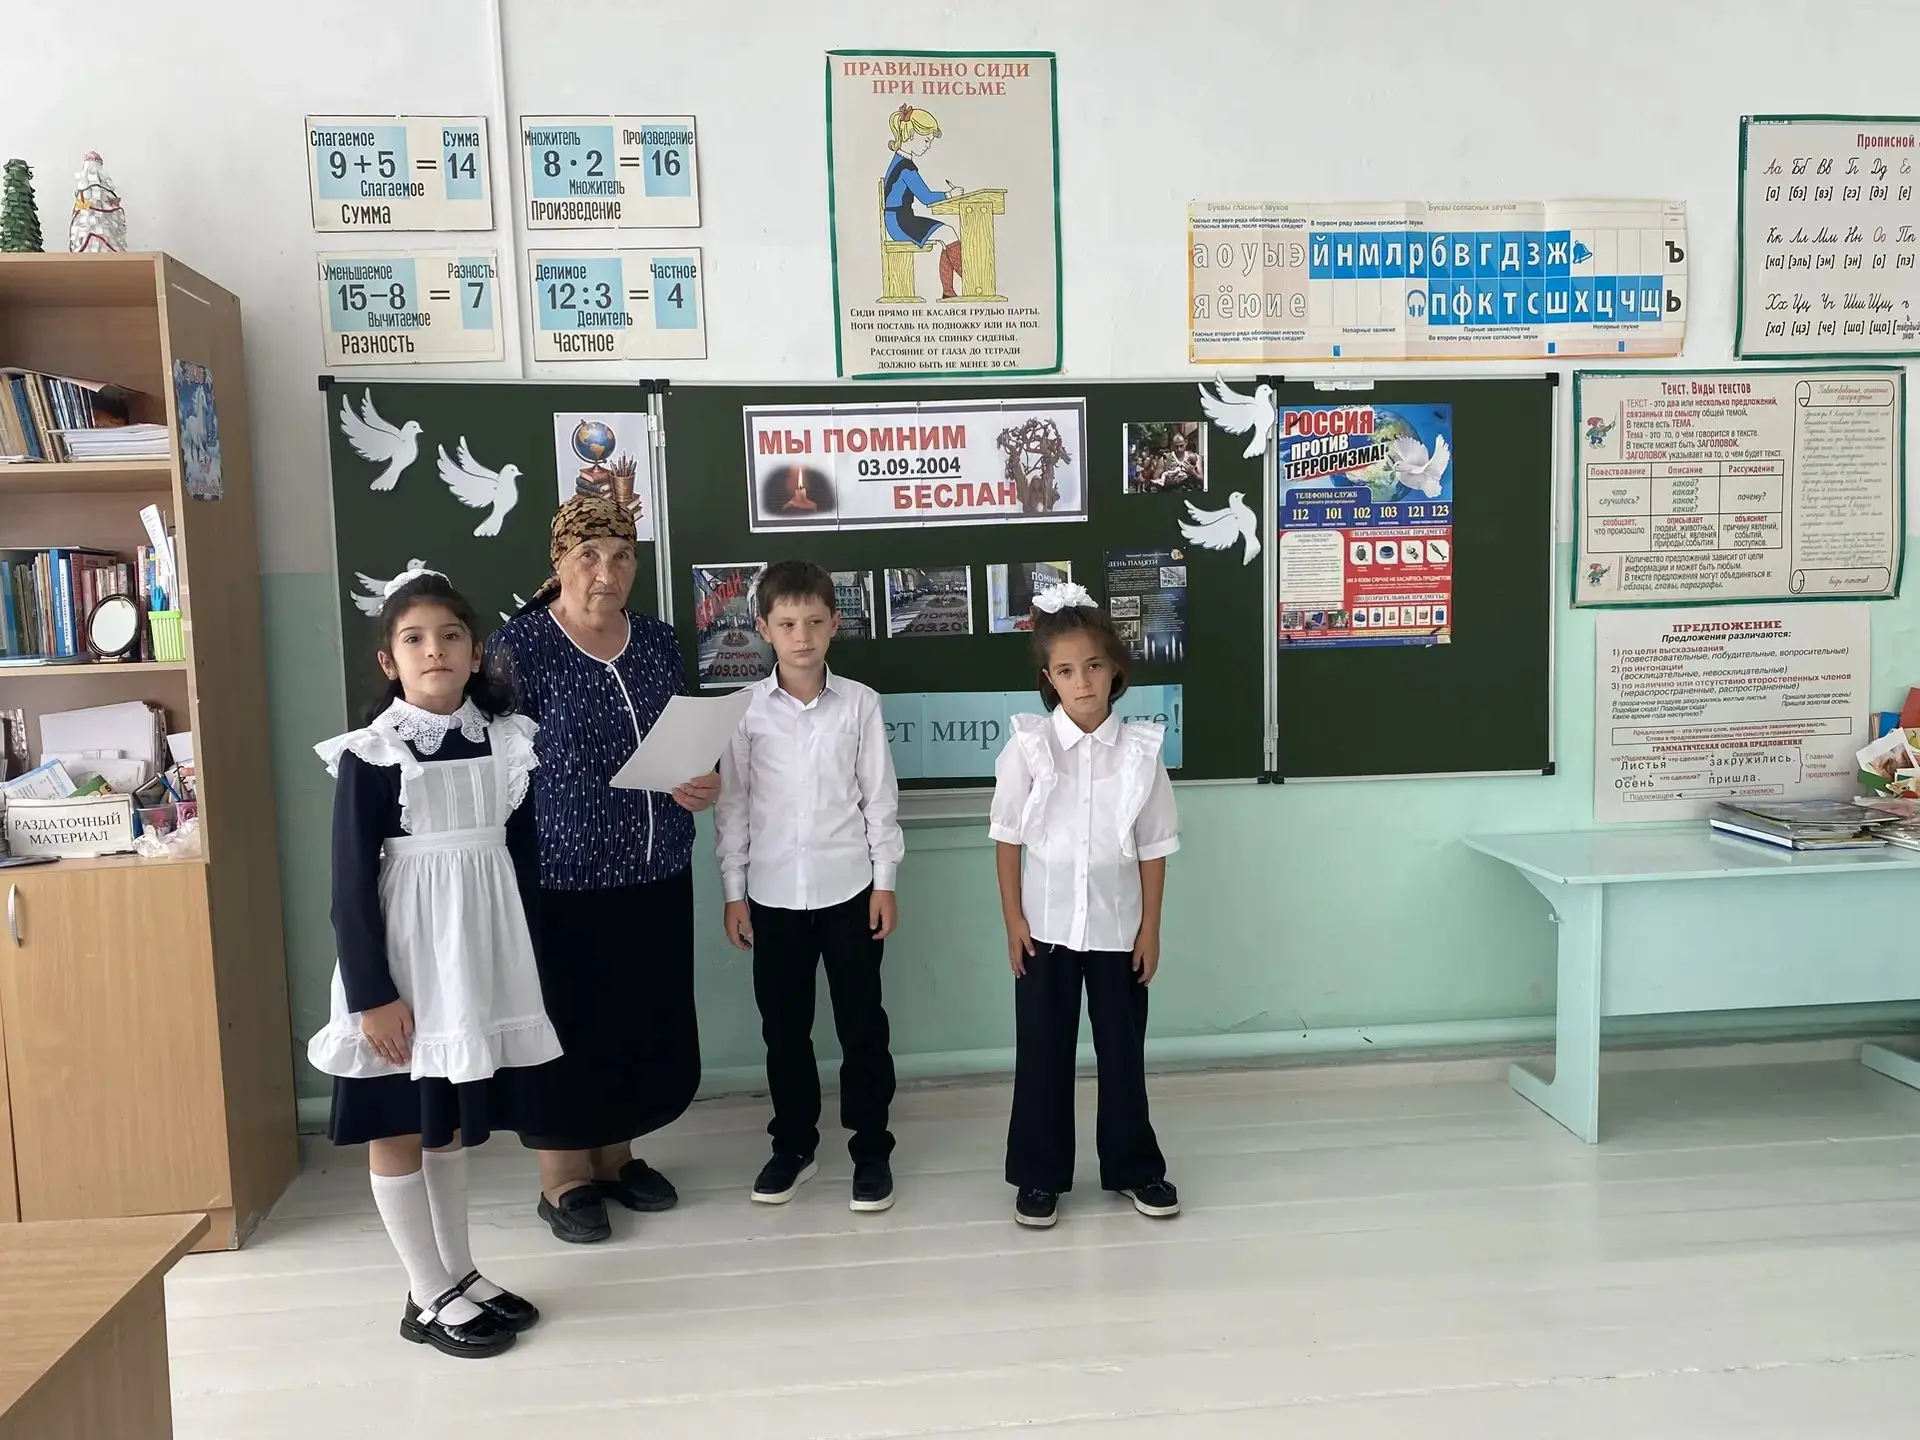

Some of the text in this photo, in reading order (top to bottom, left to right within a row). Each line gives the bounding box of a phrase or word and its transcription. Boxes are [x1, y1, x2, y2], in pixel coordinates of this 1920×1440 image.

[843, 62, 1030, 78] ПРАВИЛЬНО СИДИ
[872, 80, 1007, 96] ПРИ ПИСЬМЕ
[310, 130, 479, 148] Слагаемое Сумма
[524, 129, 693, 146] Множитель Произведение
[1857, 134, 1914, 148] Прописной
[447, 153, 476, 179] 14
[651, 150, 681, 176] 16
[360, 180, 424, 197] Слагаемое
[569, 179, 625, 194] Множитель
[341, 204, 391, 224] Сумма
[531, 201, 621, 221] Произведение
[323, 263, 495, 280] Уменьшаемое Разность
[535, 264, 697, 280] Делимое Частное
[467, 282, 484, 308] 7
[668, 283, 683, 309] 4
[368, 311, 430, 327] Вычитаемое
[577, 311, 633, 327] Делитель
[341, 334, 414, 354] Разность
[553, 333, 614, 352] Частное
[1662, 382, 1751, 395] Текст. Виды текстов
[1627, 399, 1648, 407] ТЕКСТ
[1285, 411, 1374, 436] РОССИЯ
[1672, 420, 1691, 428] ТЕМА
[758, 425, 967, 455] МЫ ПОМНИМ
[1291, 434, 1349, 459] ПРОТИВ
[858, 456, 961, 476] 03.09.2004
[1285, 444, 1385, 480] ТЕРРОРИЗМА!
[1729, 465, 1775, 473] Рассуждение
[1672, 479, 1699, 487] какой?
[893, 482, 1017, 509] БЕСЛАН
[1672, 488, 1698, 496] какая?
[1738, 492, 1766, 502] почему?
[1599, 496, 1640, 505] случилось?
[1292, 505, 1449, 520] 112 101 102 103 121 123
[1667, 516, 1703, 524] описывает
[1735, 515, 1767, 523] объясняет
[1673, 621, 1782, 633] ПРЕДЛОЖЕНИЕ
[1662, 630, 1792, 643] Предложения различаются:
[1635, 647, 1657, 656] цели
[1659, 645, 1724, 654] высказывания
[1634, 664, 1683, 672] интонации
[931, 718, 999, 749] мир
[1621, 754, 1796, 771] Листья закружились.
[1615, 774, 1761, 789] Осень пришла.
[15, 812, 121, 831] РАЗДАТОЧНЫЙ
[30, 833, 109, 845] МАТЕРИАЛ
